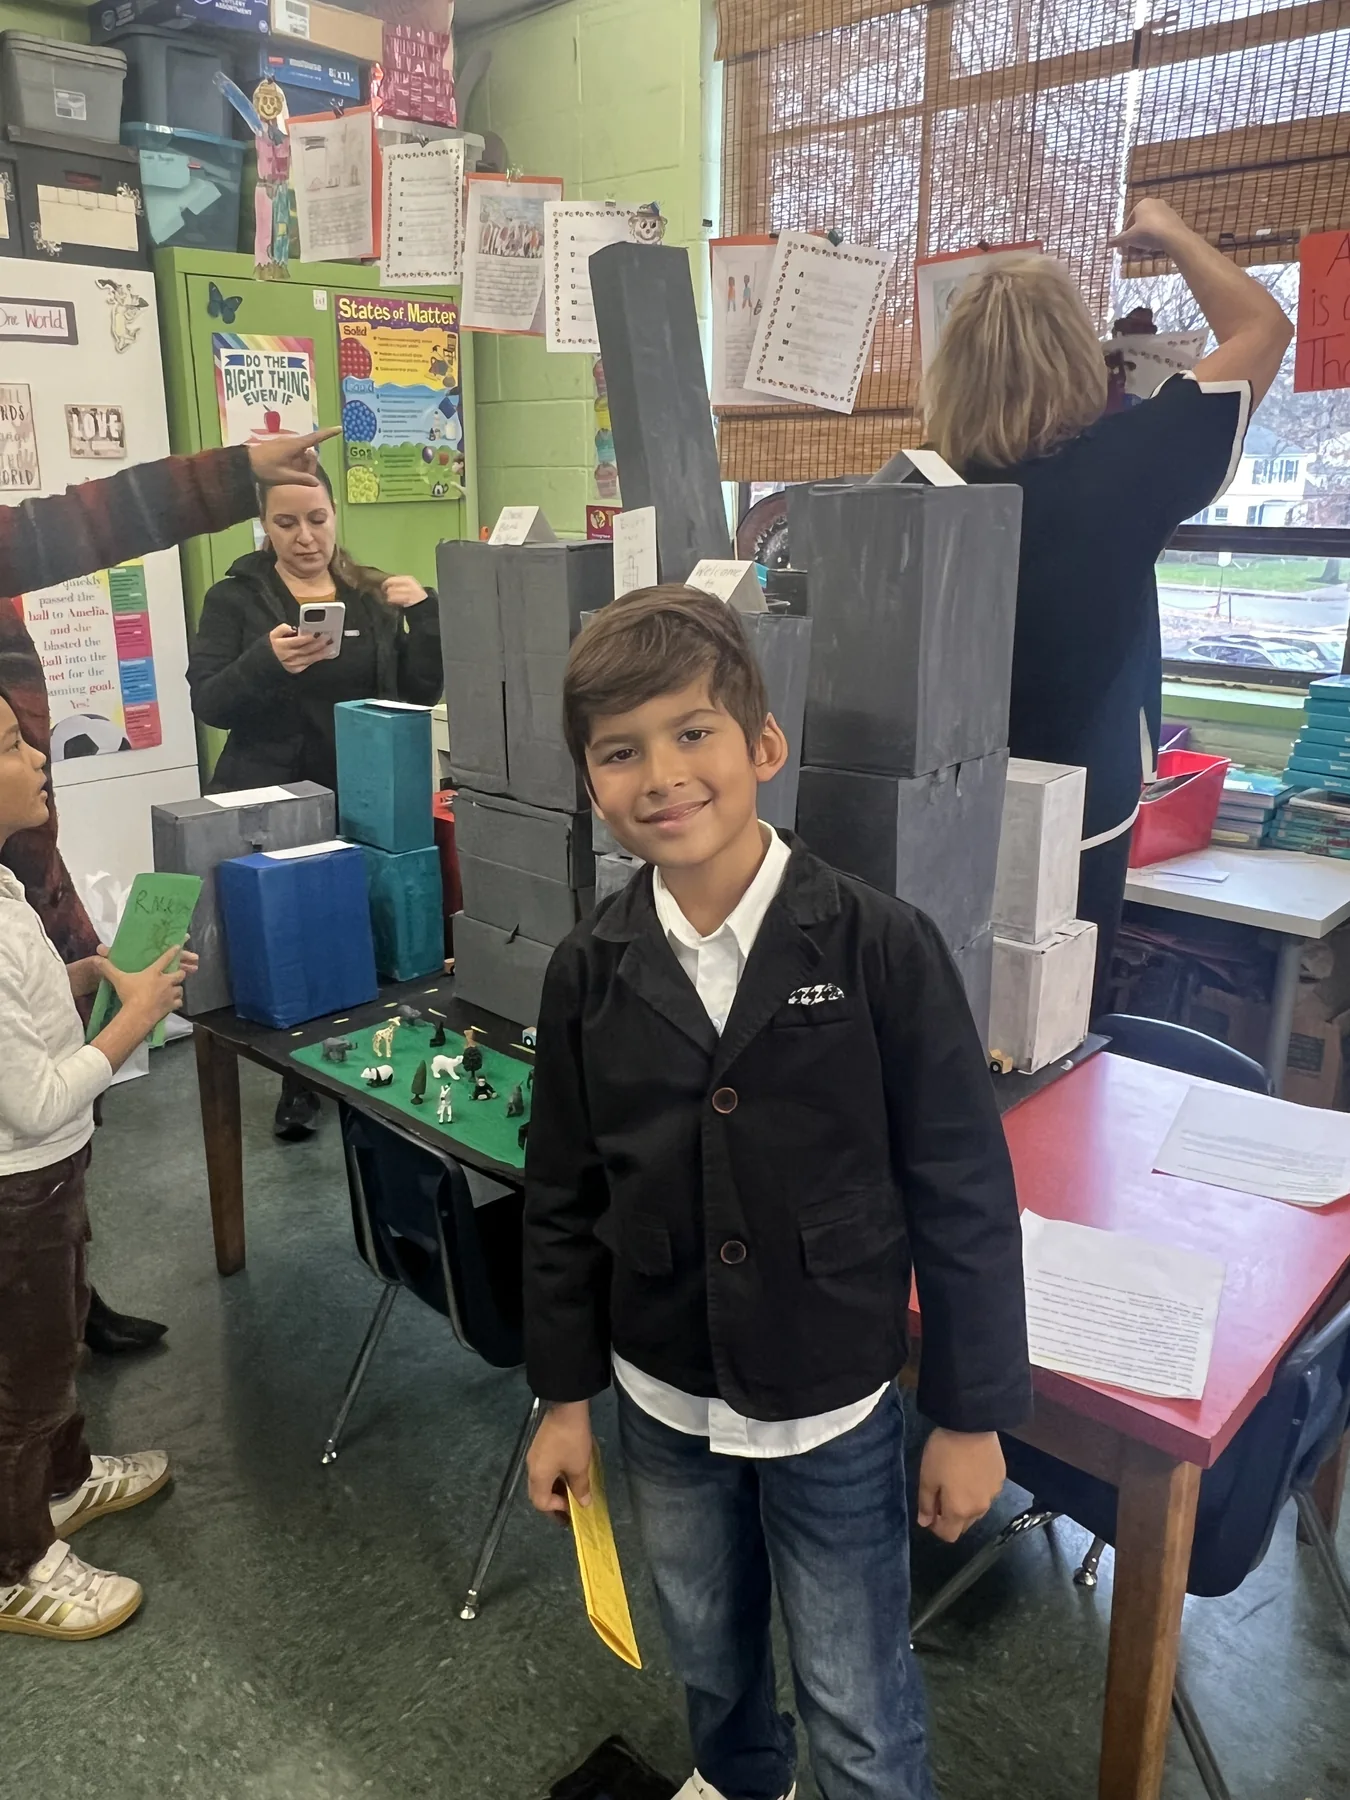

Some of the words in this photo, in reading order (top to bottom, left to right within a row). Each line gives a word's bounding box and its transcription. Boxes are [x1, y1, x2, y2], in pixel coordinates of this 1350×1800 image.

[339, 298, 391, 320] States
[393, 307, 404, 319] of
[407, 303, 456, 324] Matter
[1312, 288, 1330, 327] is
[25, 308, 65, 329] World
[343, 325, 367, 336] Solid
[246, 355, 260, 367] DO
[264, 356, 286, 368] THE
[224, 369, 264, 401] RIGHT
[269, 371, 309, 401] THING
[243, 389, 277, 406] EVEN
[282, 393, 293, 405] IF
[72, 413, 119, 439] LOVE
[350, 447, 372, 459] Gas
[0, 469, 34, 486] ORLD
[695, 564, 742, 578] Welcome
[63, 577, 101, 590] quickly
[39, 592, 74, 608] passed
[77, 592, 95, 601] the
[29, 610, 49, 621] ball
[53, 611, 63, 619] to
[50, 624, 70, 635] and
[74, 623, 91, 633] she
[44, 638, 81, 651] blasted
[85, 637, 101, 646] the
[42, 656, 62, 667] ball
[65, 655, 87, 664] into
[90, 652, 107, 661] the
[49, 671, 65, 681] net
[68, 669, 84, 679] for
[88, 667, 104, 677] the
[89, 680, 115, 694] goal.
[70, 698, 90, 709] Yes!
